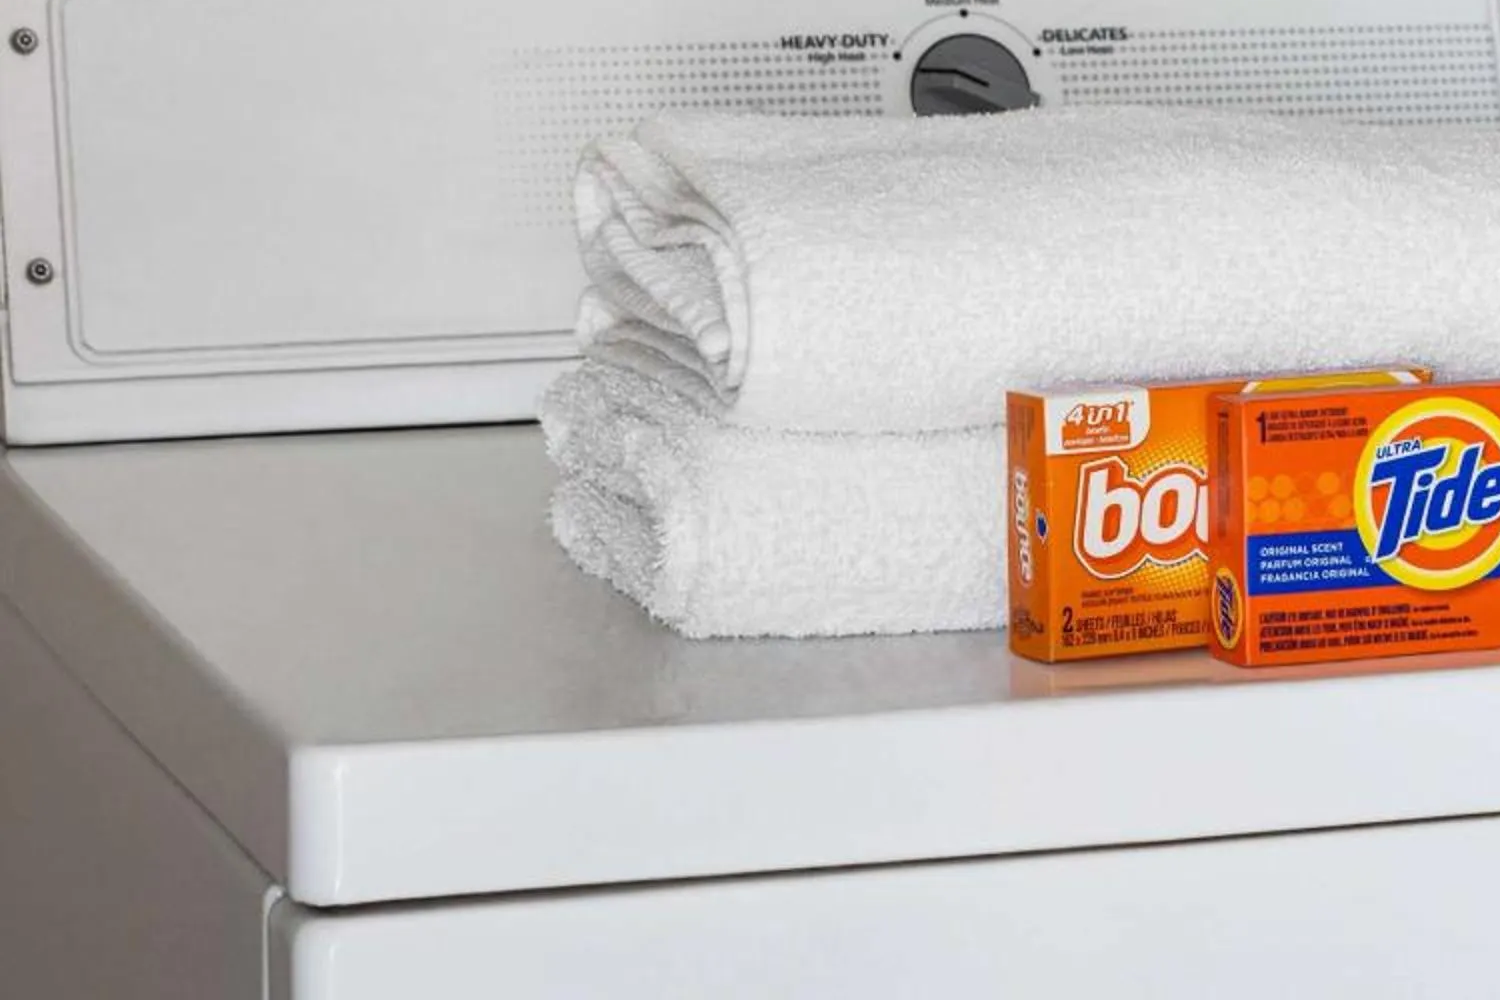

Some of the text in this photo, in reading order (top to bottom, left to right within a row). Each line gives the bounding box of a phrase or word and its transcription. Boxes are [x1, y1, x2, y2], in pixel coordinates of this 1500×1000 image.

[1042, 27, 1127, 43] DELICATES
[1256, 411, 1267, 444] 1
[1376, 440, 1421, 459] ULTRA
[1260, 542, 1343, 557] ORIGINAL SCENT
[1260, 556, 1352, 571] PARFUM ORIGINAL
[1321, 568, 1370, 580] ORIGINAL
[1062, 606, 1073, 633] 2
